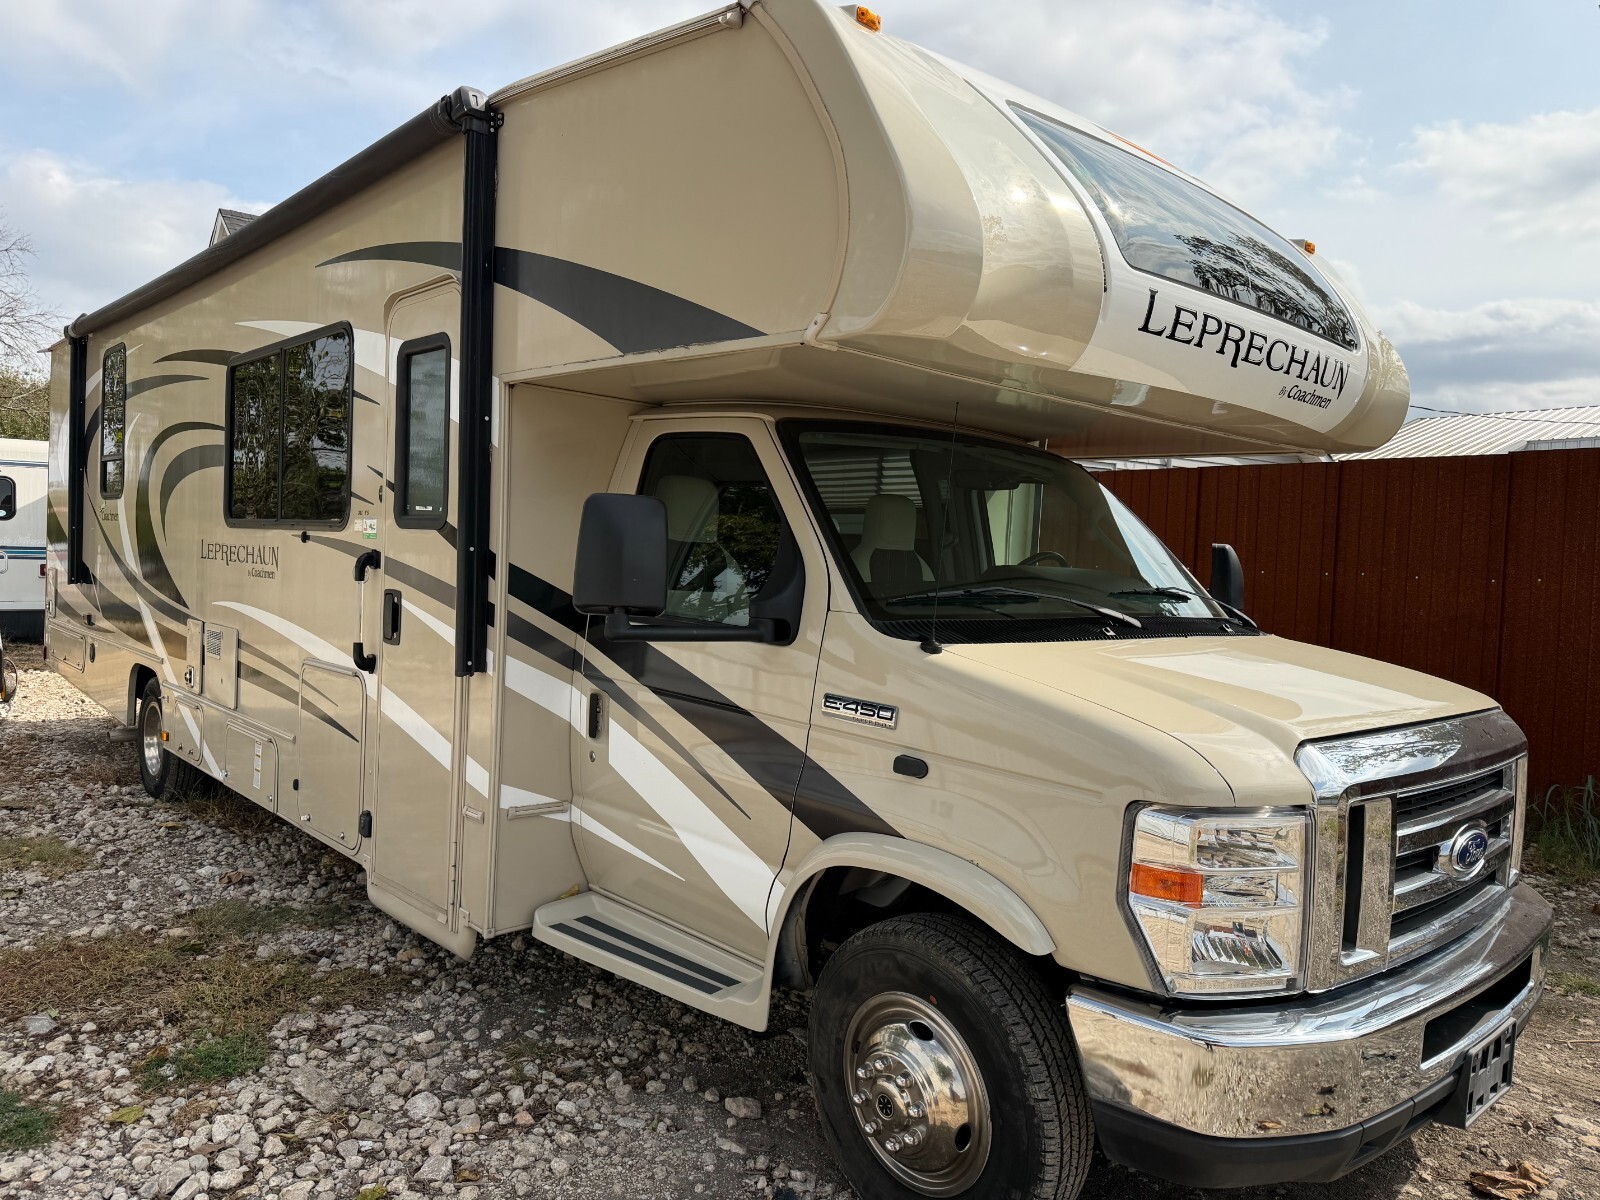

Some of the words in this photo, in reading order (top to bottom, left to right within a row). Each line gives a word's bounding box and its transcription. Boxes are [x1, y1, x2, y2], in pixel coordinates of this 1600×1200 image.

[1138, 287, 1350, 399] LEPRECHAUN
[1278, 386, 1288, 399] By
[1287, 384, 1332, 409] Coachmen
[200, 539, 279, 571] LEPRECHAUN
[823, 695, 895, 721] E-450
